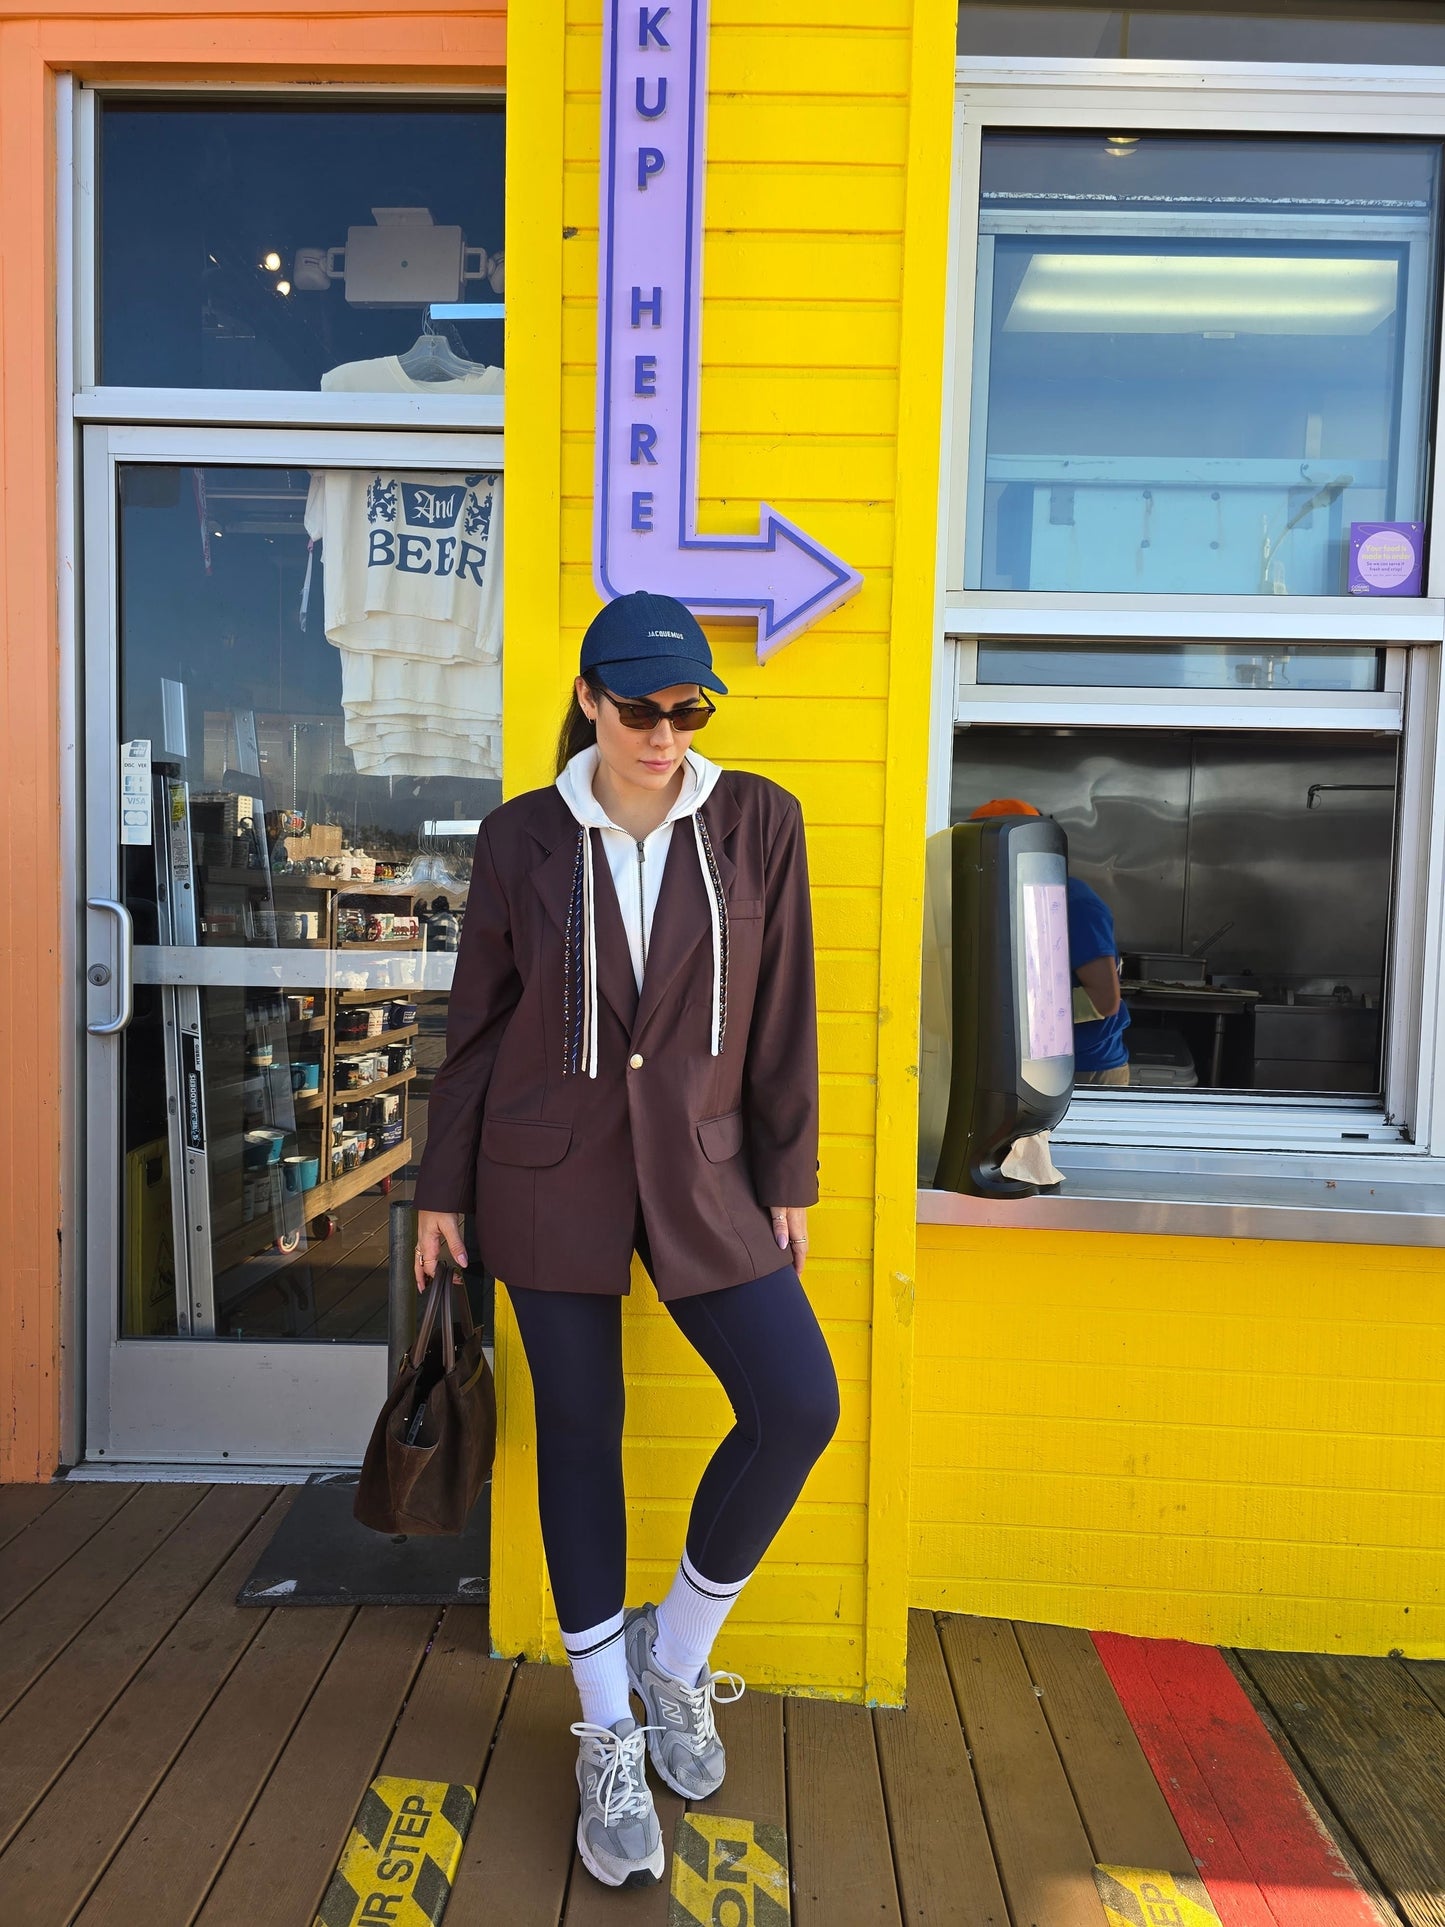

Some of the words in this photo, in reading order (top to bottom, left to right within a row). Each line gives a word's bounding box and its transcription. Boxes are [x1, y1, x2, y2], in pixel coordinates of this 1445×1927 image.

[636, 7, 671, 191] KUP
[631, 287, 662, 532] HERE
[411, 490, 456, 523] And
[368, 529, 487, 587] BEER
[647, 630, 684, 640] JACQUEMUS
[127, 797, 146, 805] VISA
[659, 1696, 684, 1725] N
[376, 1795, 433, 1883] STEP
[712, 1838, 748, 1927] ON
[1140, 1883, 1185, 1927] EP
